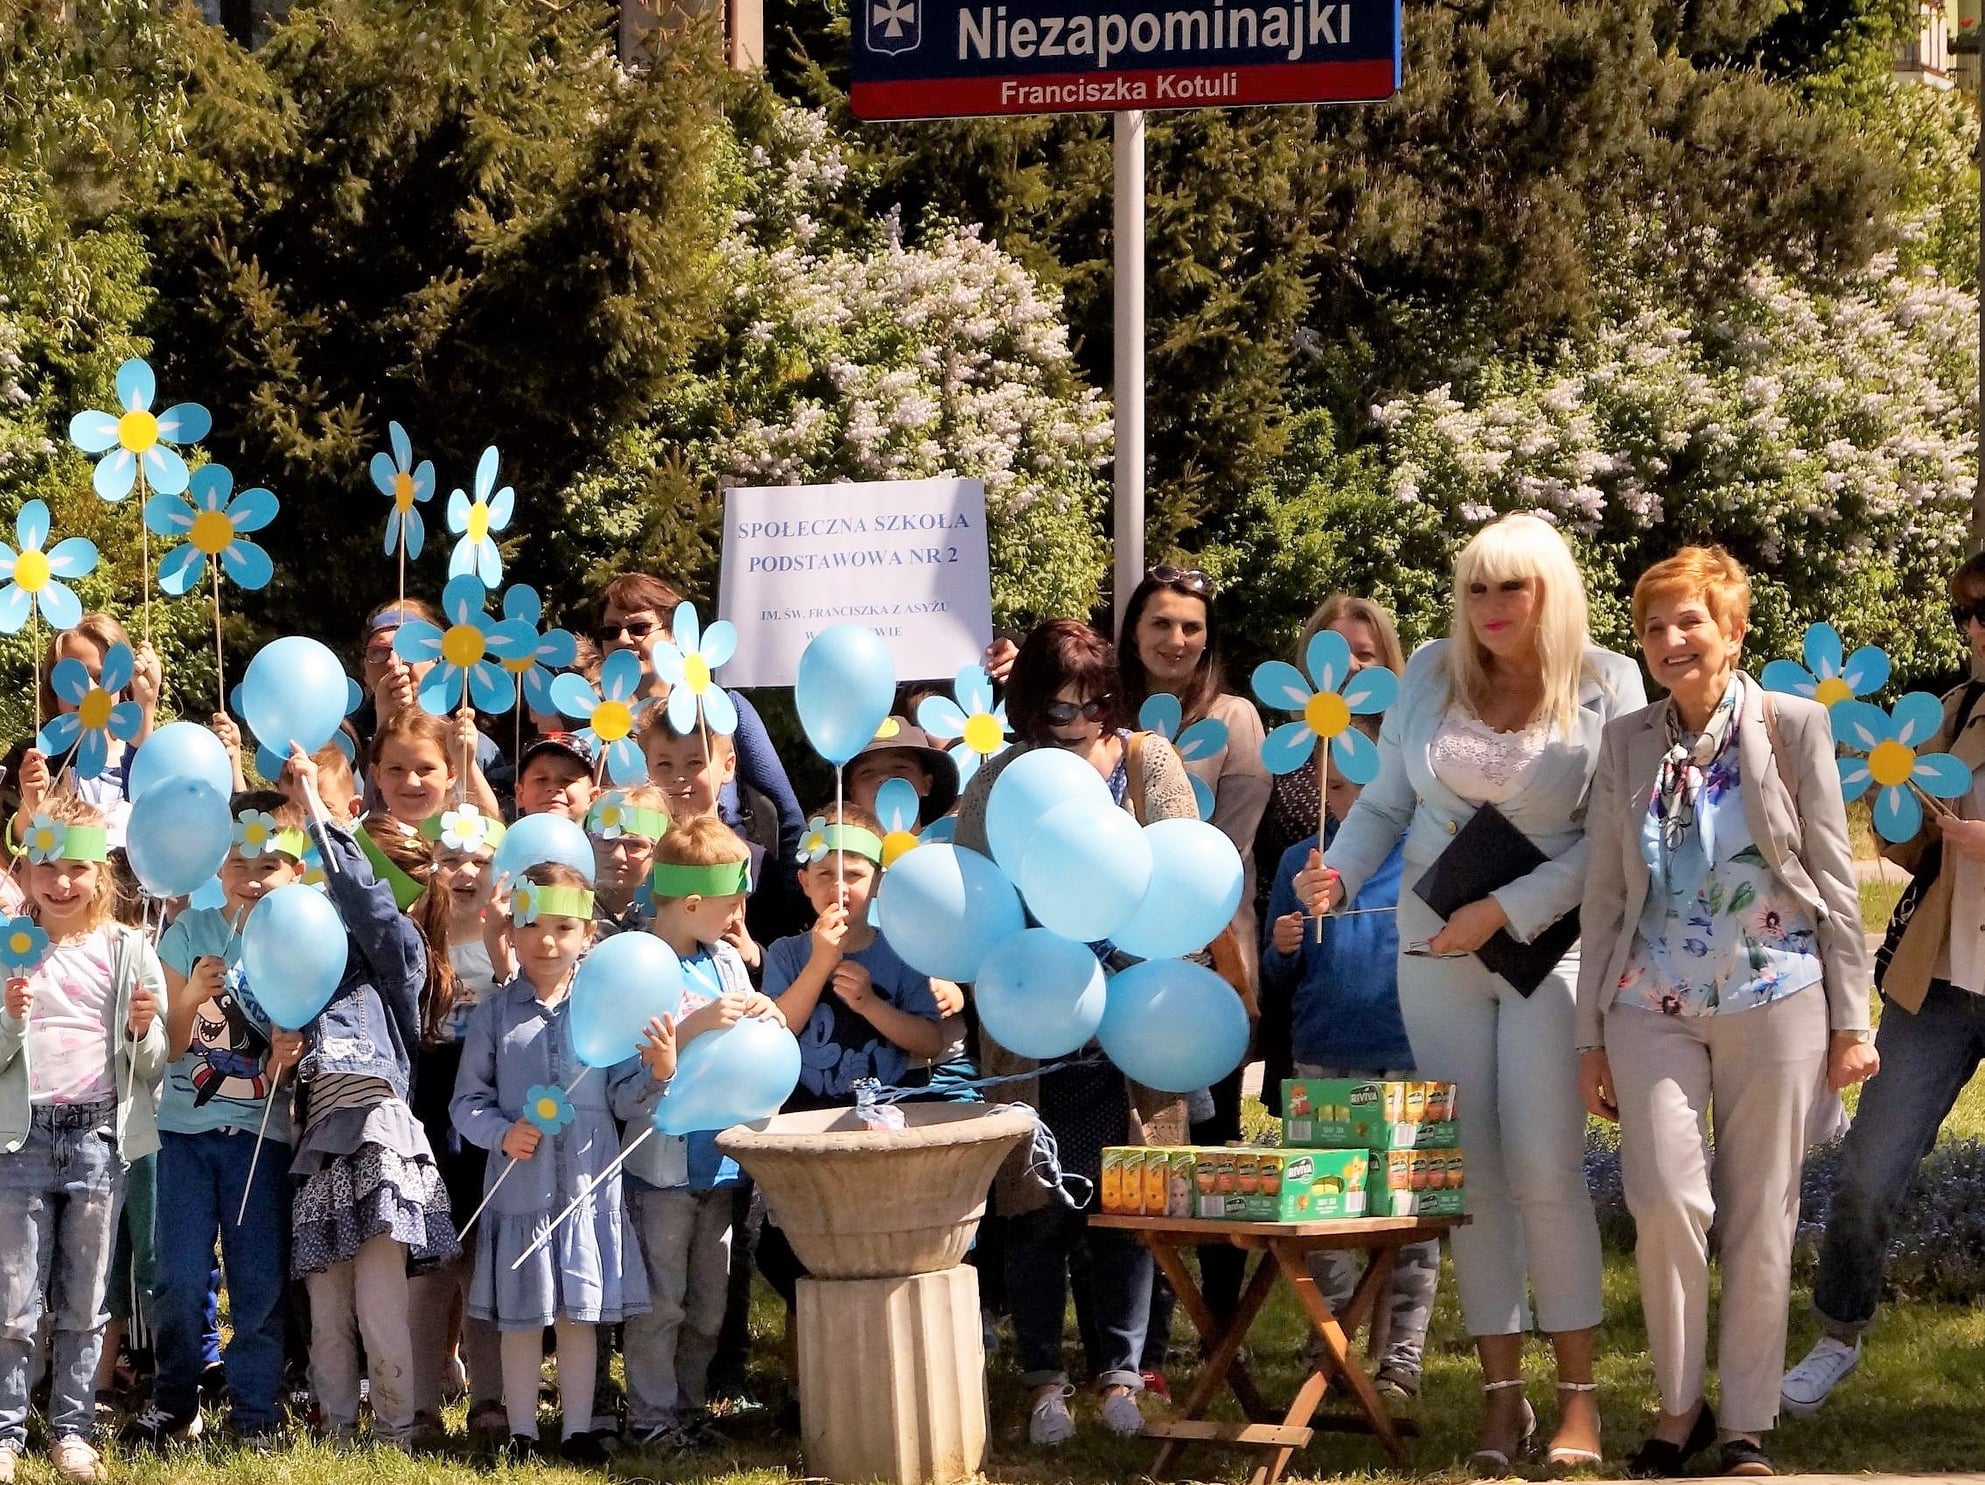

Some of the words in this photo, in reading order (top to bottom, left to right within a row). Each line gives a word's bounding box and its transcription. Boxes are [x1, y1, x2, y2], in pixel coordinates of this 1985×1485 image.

[958, 0, 1351, 68] Niezapominajki
[1001, 76, 1148, 105] Franciszka
[1156, 72, 1238, 101] Kotuli
[738, 515, 867, 539] SPOŁECZNA
[874, 513, 970, 532] SZKOŁA
[749, 550, 902, 573] PODSTAWOWA
[910, 547, 942, 565] NR
[948, 547, 959, 563] 2
[762, 610, 782, 621] IM.
[784, 607, 806, 619] ŚW.
[809, 603, 889, 619] FRANCISZKA
[892, 604, 902, 614] Z
[1350, 1089, 1378, 1104] RIVIVA
[1287, 1162, 1313, 1179] RIVIVA
